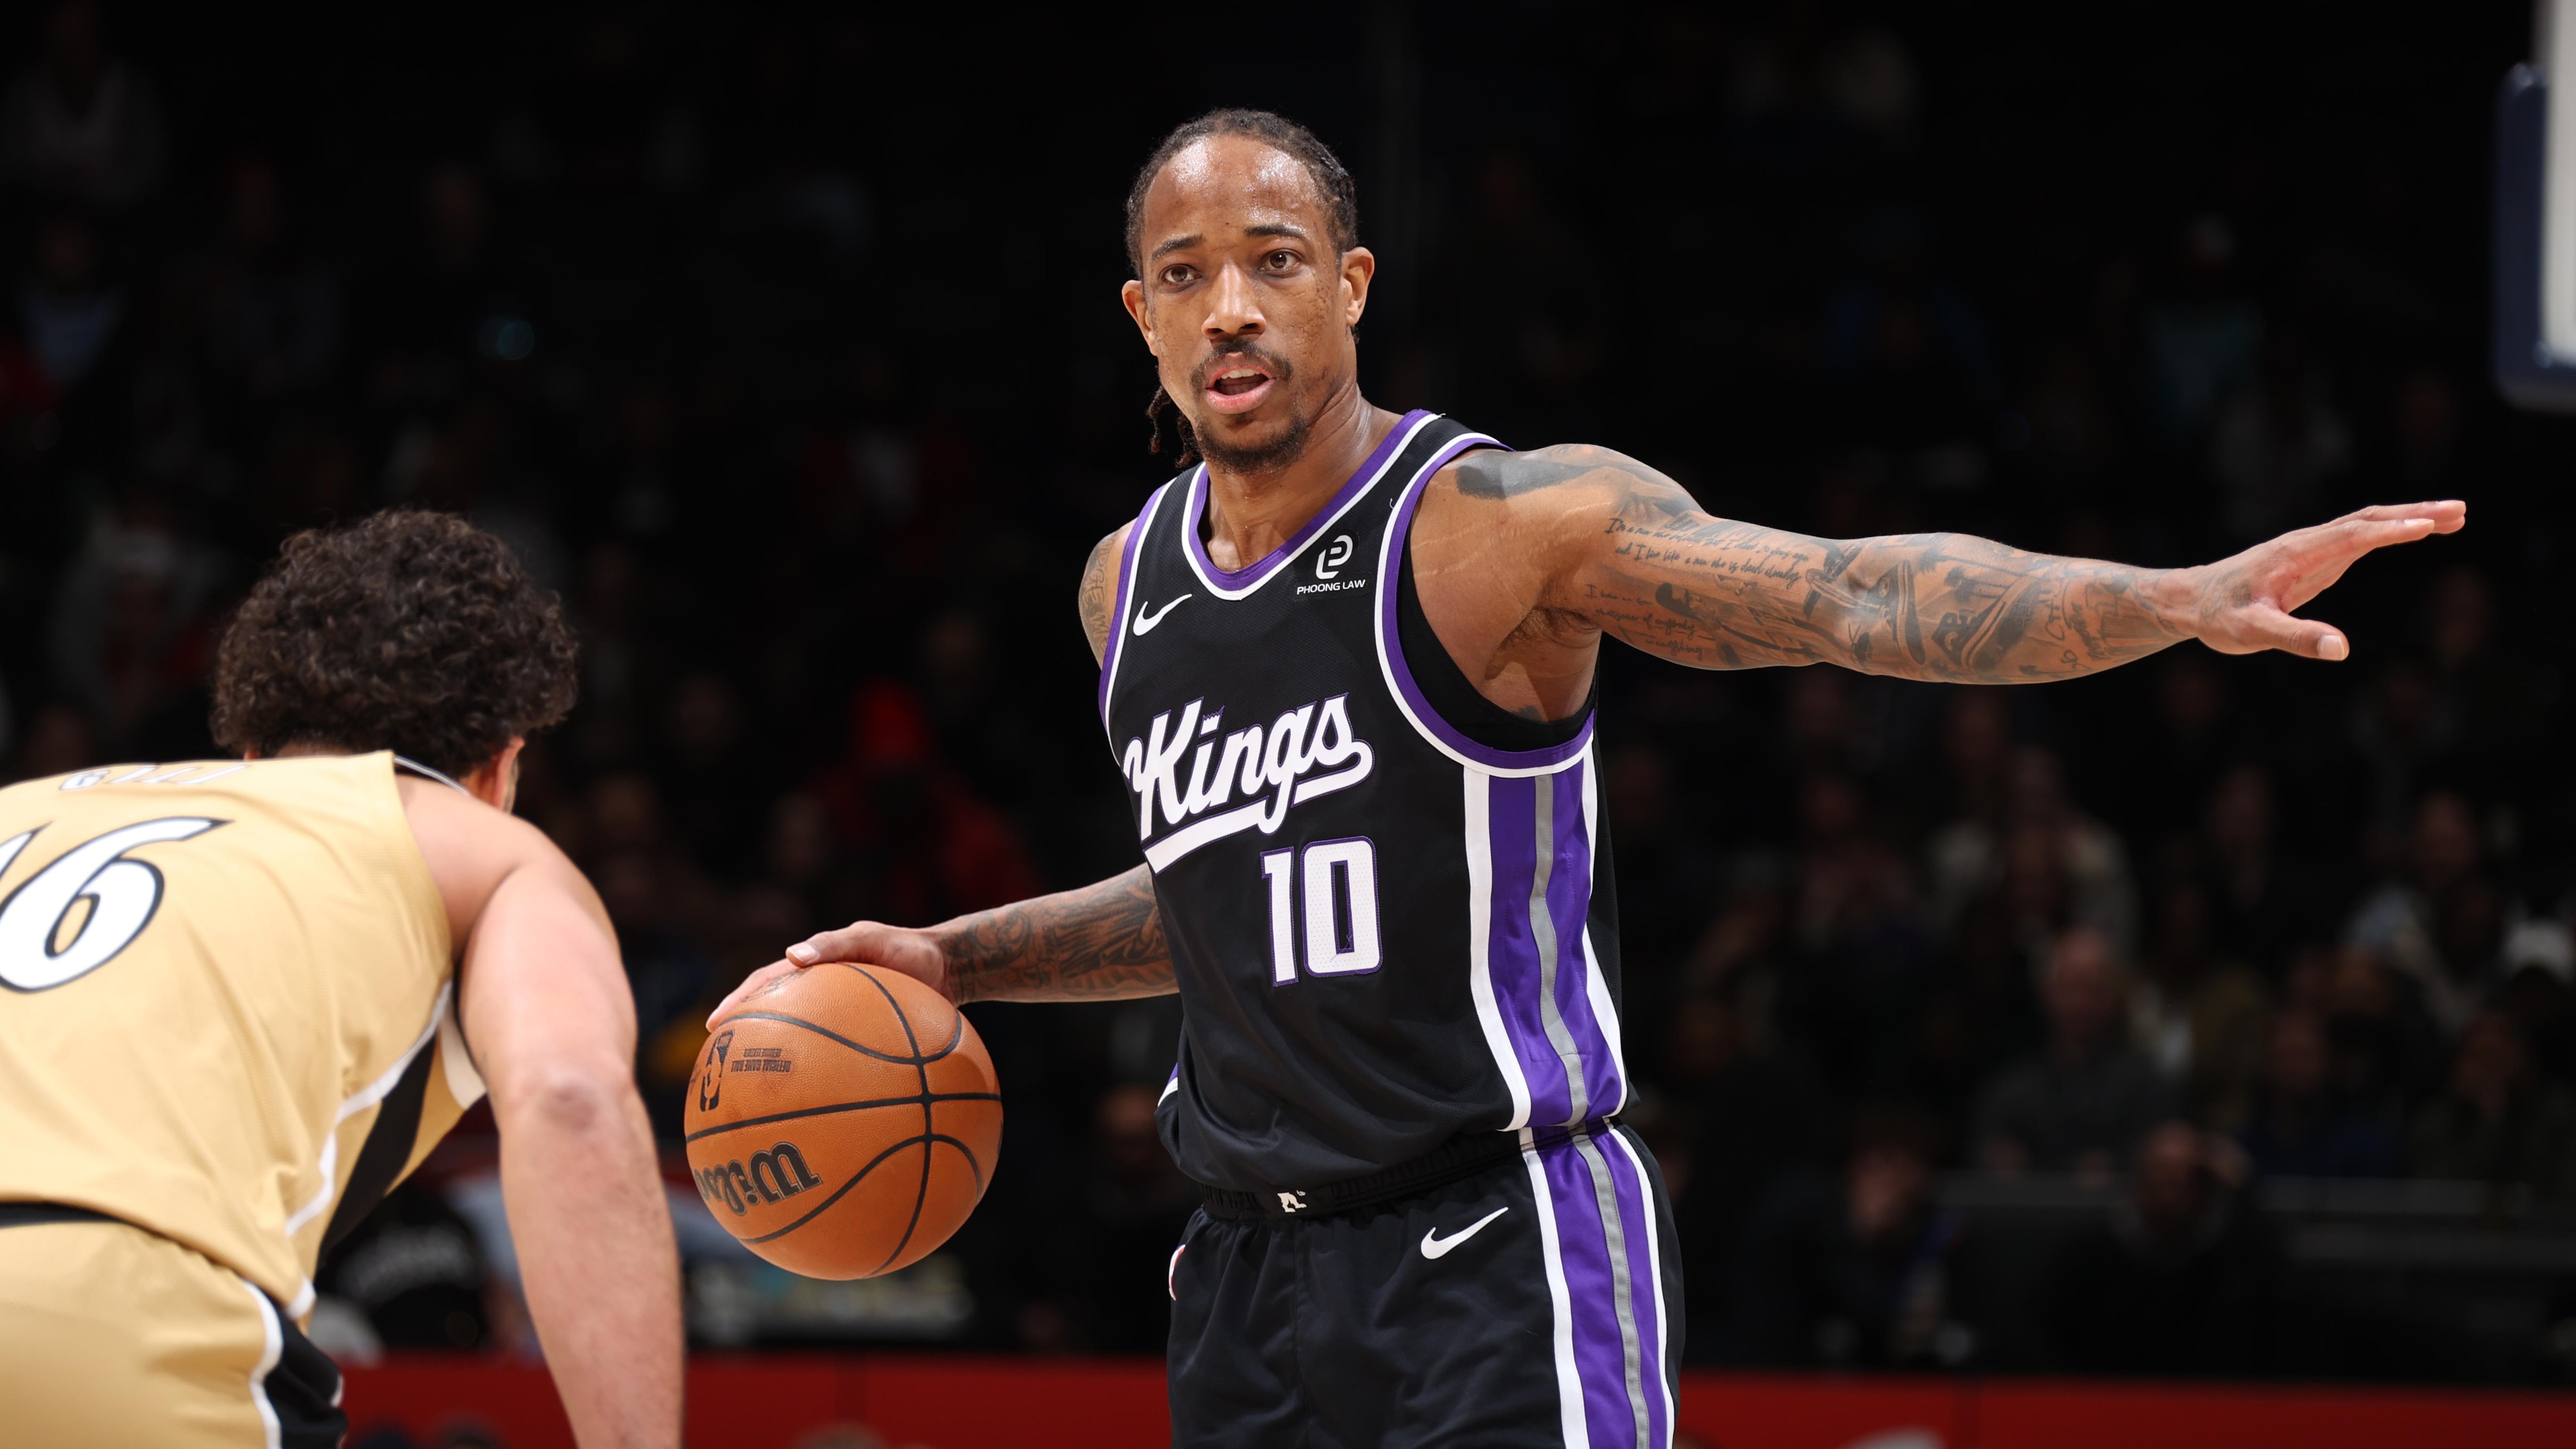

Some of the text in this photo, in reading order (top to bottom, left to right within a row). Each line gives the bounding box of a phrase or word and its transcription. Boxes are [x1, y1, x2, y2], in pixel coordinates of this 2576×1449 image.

[1296, 579, 1366, 595] PHOONG LAW
[1615, 542, 1633, 555] and
[1634, 543, 1647, 561] I
[1123, 692, 1375, 876] Kings
[0, 816, 235, 994] 6
[1260, 836, 1383, 987] 10
